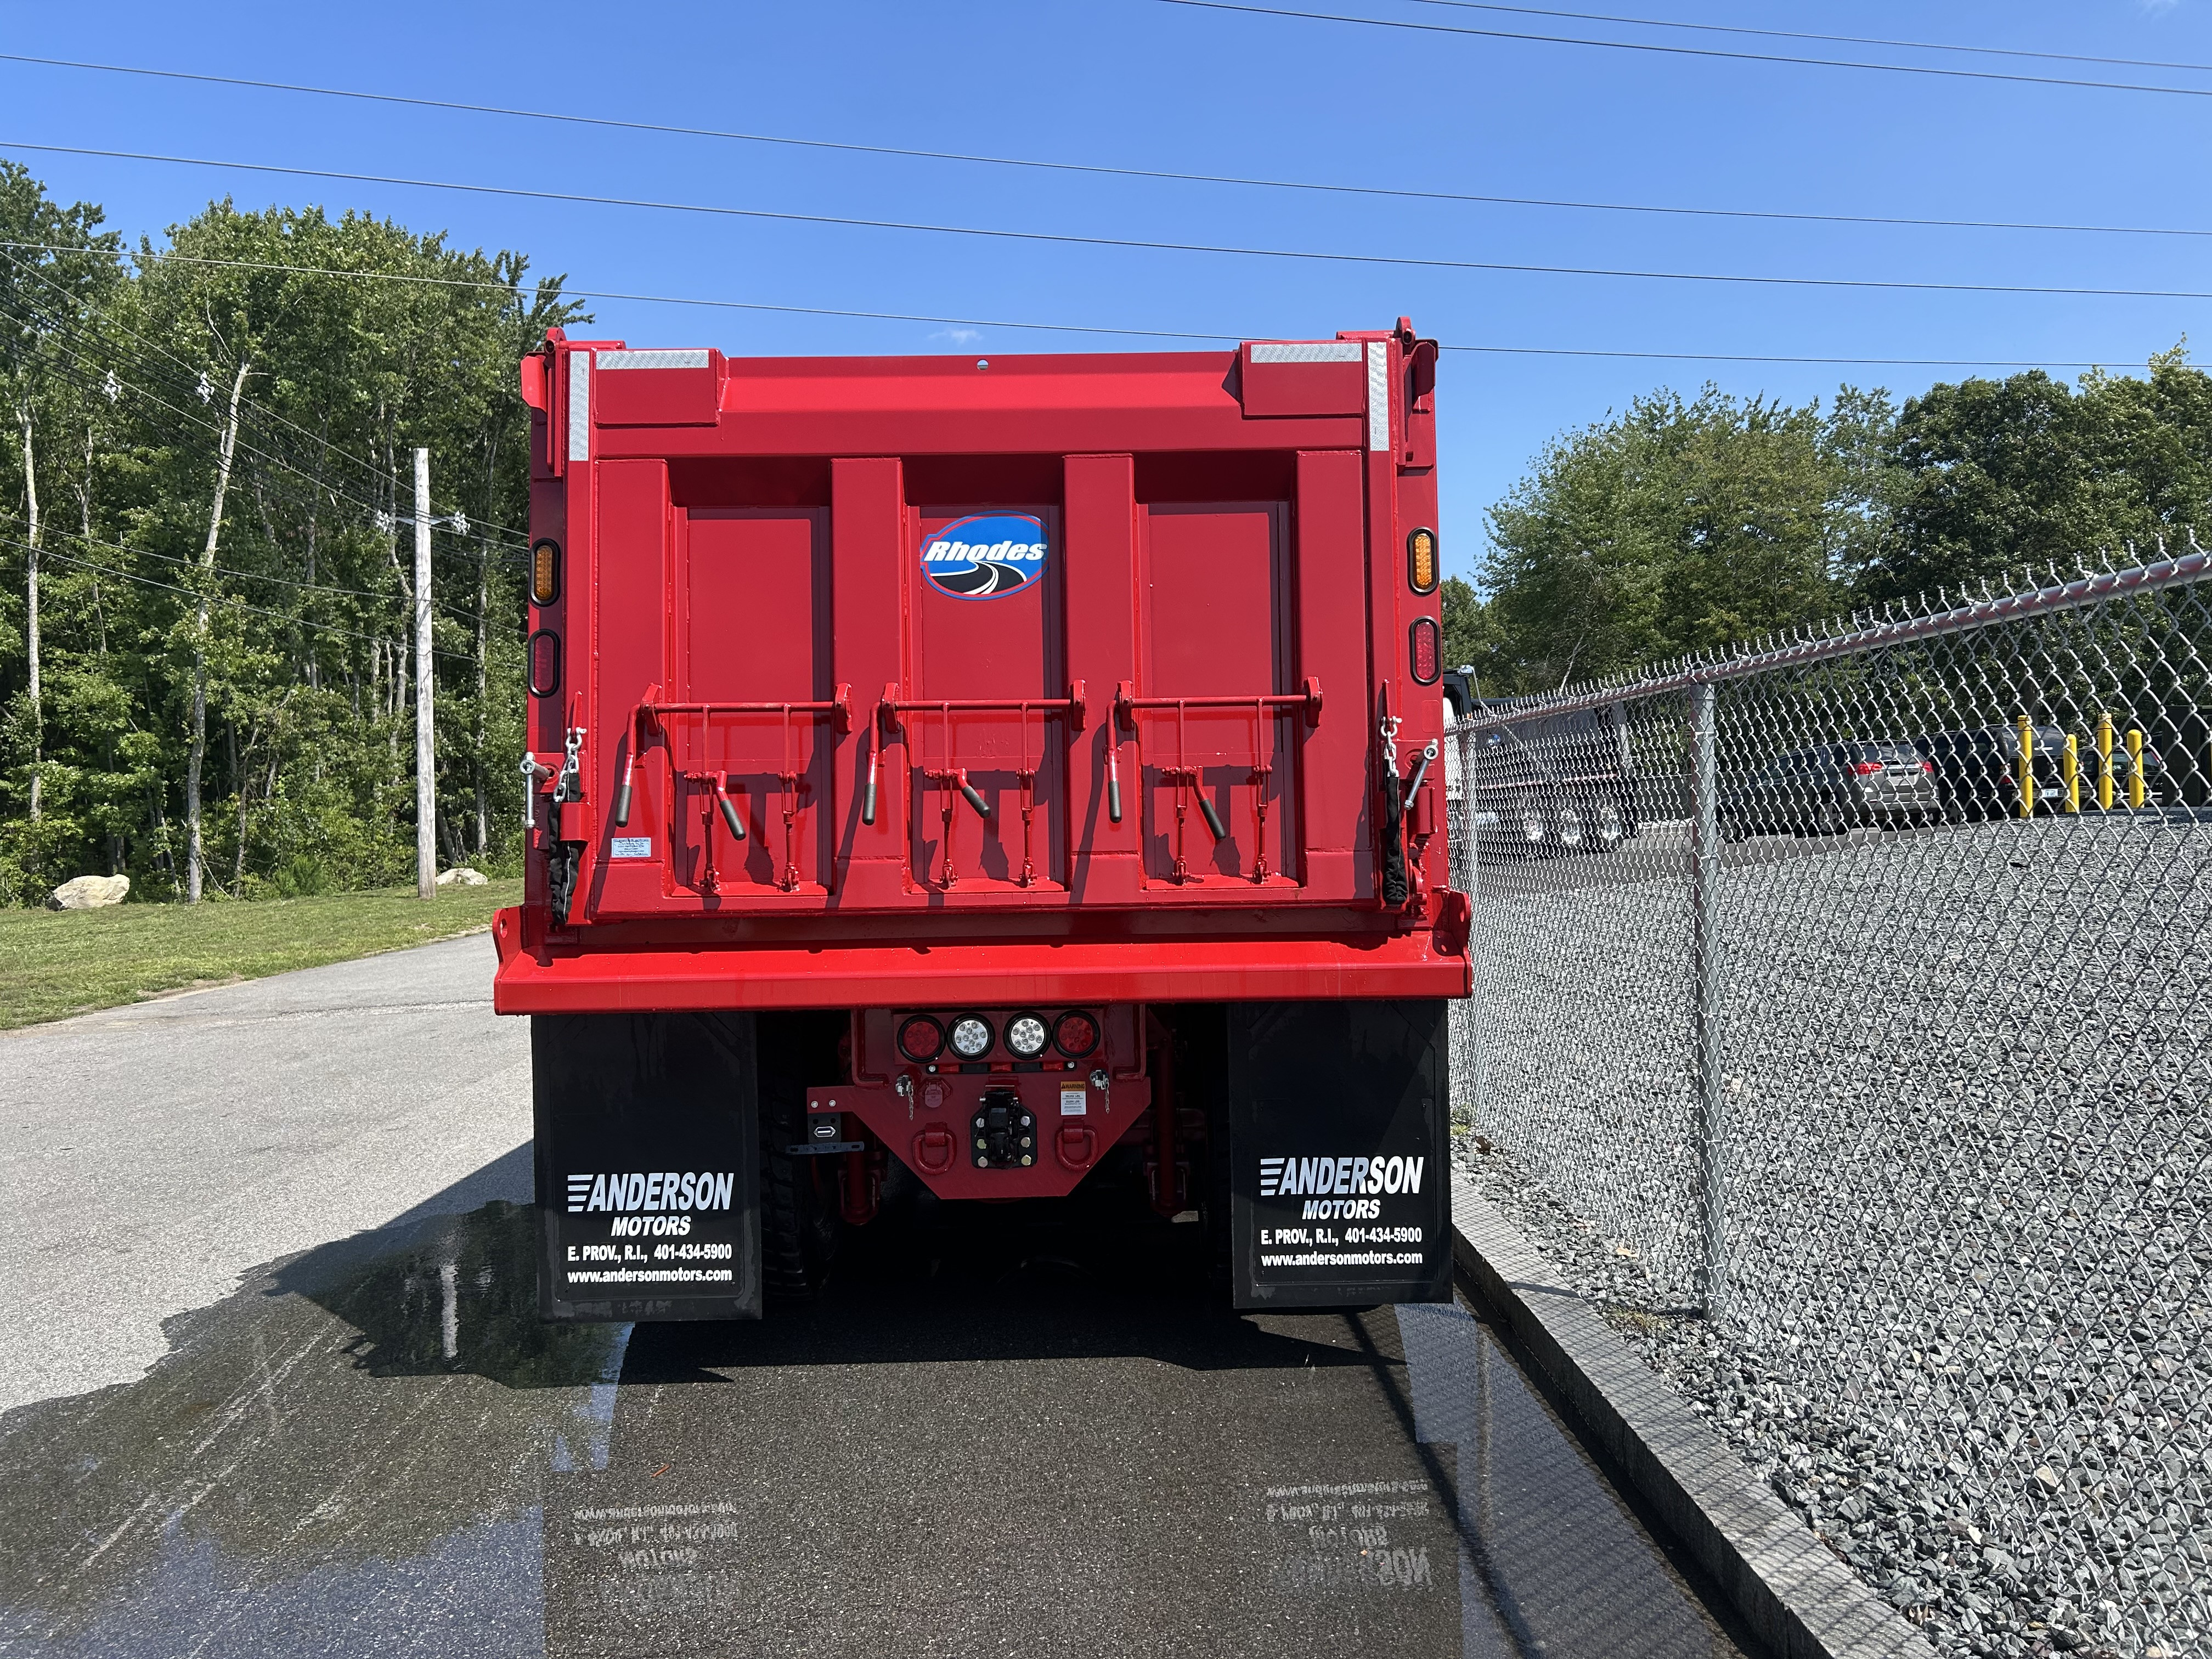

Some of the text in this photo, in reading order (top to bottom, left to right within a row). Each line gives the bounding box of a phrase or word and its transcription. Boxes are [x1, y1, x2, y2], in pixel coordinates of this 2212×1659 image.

[923, 540, 1048, 561] Rhodes
[1278, 1156, 1424, 1195] ANDERSON
[586, 1172, 734, 1212] ANDERSON
[1302, 1199, 1381, 1220] MOTORS
[611, 1215, 691, 1237] MOTORS
[1261, 1227, 1422, 1247] E. PROV., R.I., 401-434-5900
[567, 1244, 732, 1263] E. PROV., R.I., 401-434-5900
[1261, 1250, 1423, 1267] www.andersonmotors.com
[567, 1267, 732, 1283] www.andersonmotors.com
